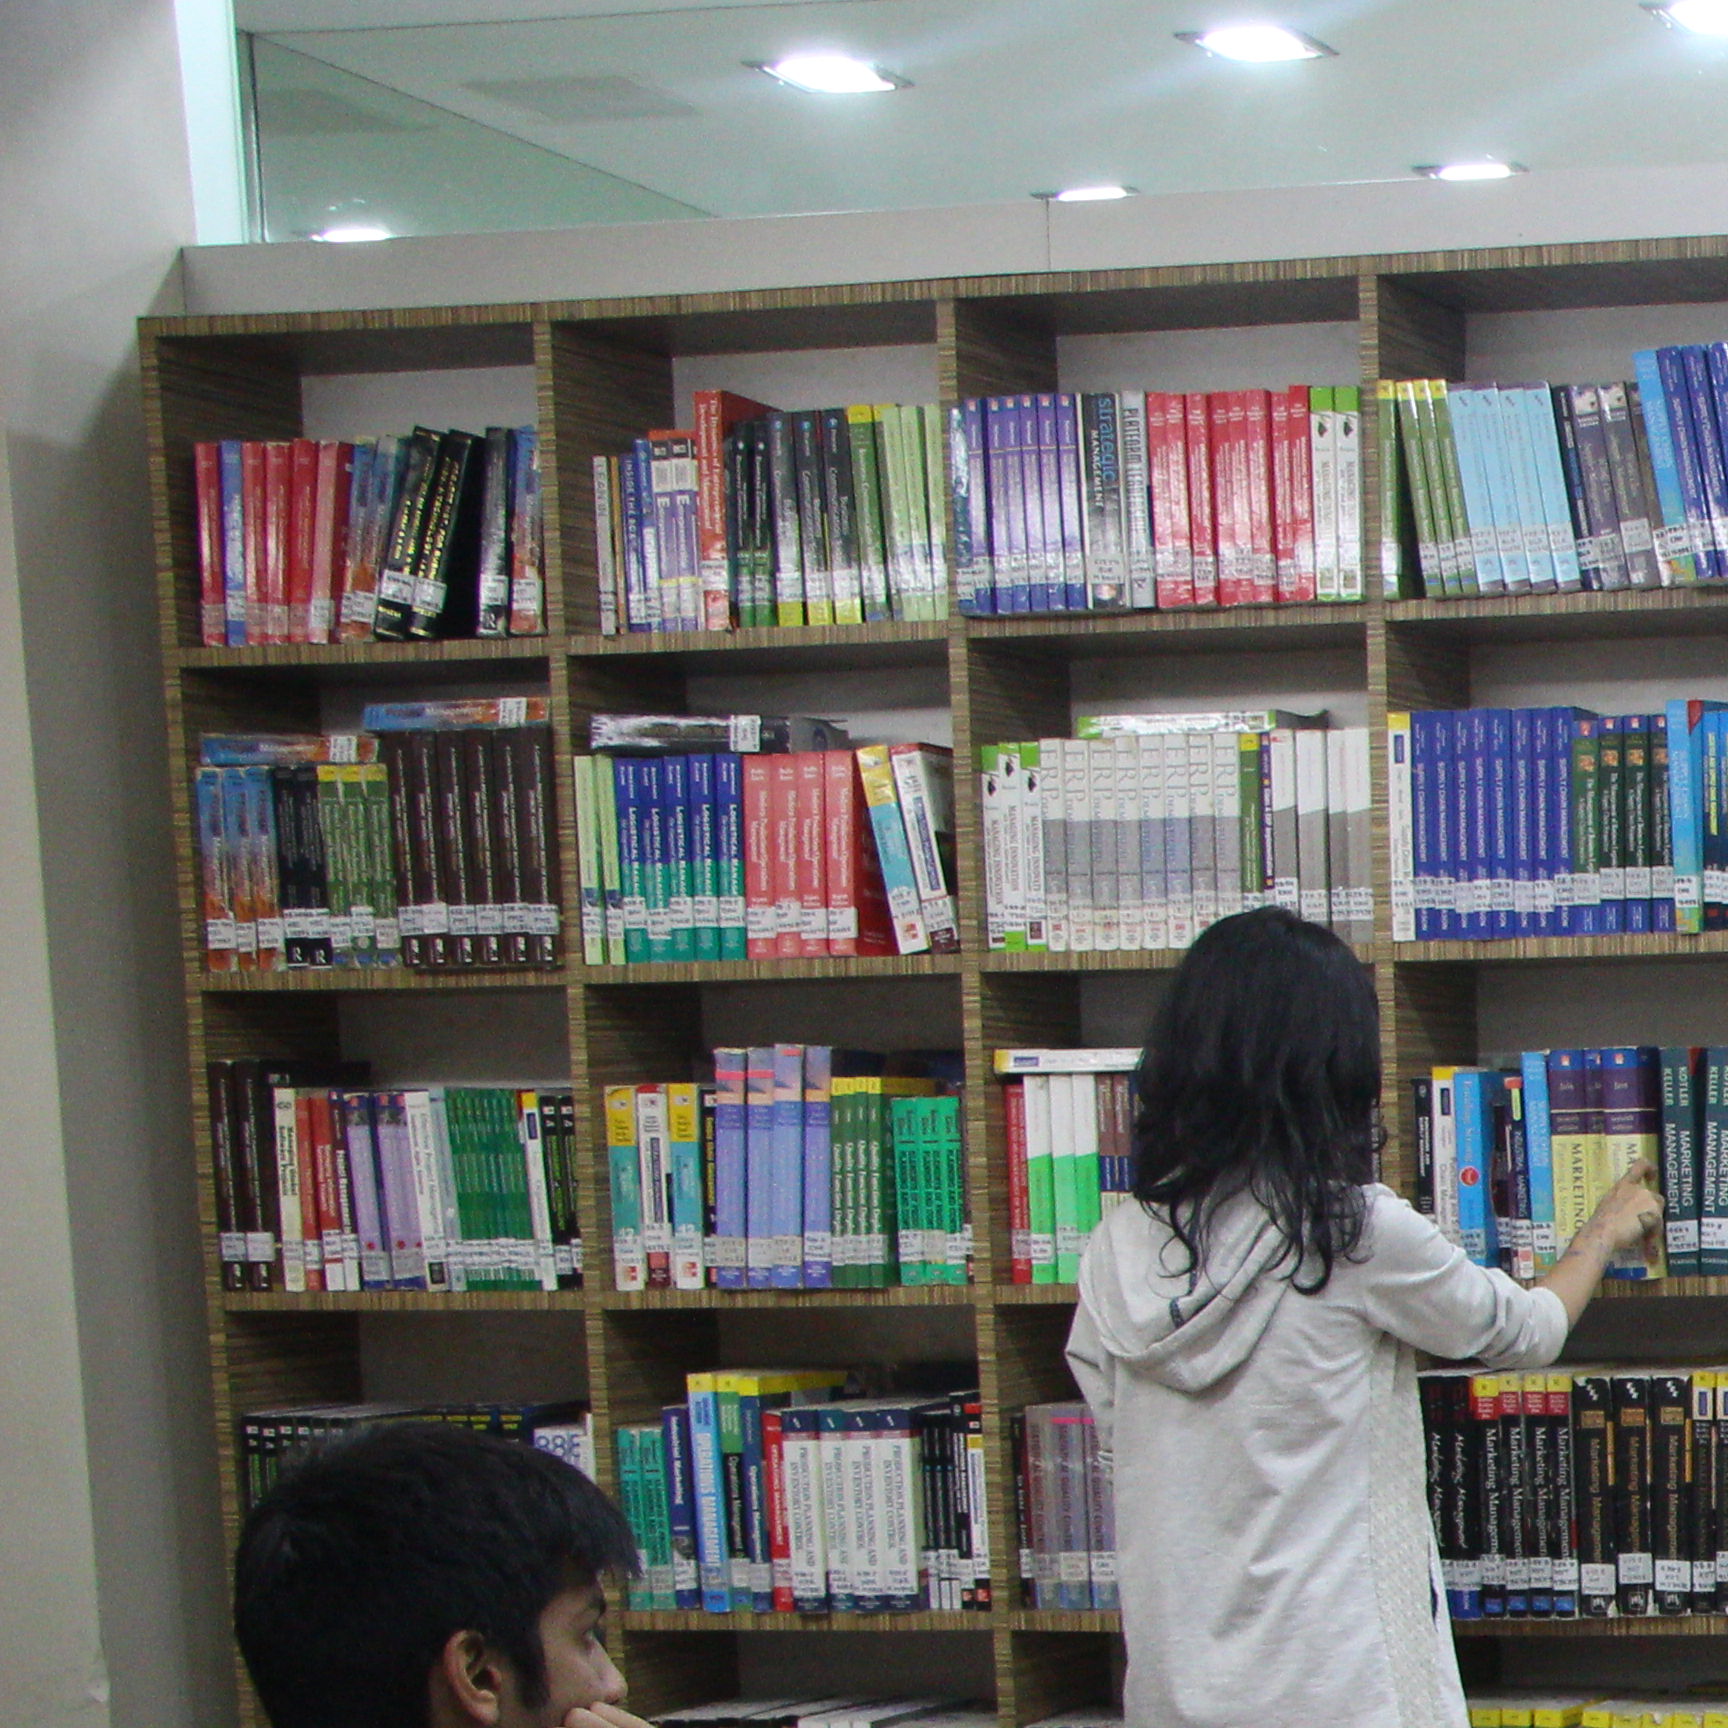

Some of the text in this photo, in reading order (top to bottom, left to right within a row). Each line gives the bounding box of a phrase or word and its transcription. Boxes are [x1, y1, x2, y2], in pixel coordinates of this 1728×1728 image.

[1099, 398, 1116, 482] strategic
[1663, 1067, 1674, 1106] KELLER
[1678, 1066, 1689, 1107] KOTLER
[1708, 1066, 1720, 1104] KELLER
[1571, 1143, 1585, 1229] MARKETING
[1665, 1123, 1682, 1215] MANAGEMENT
[1680, 1131, 1694, 1207] MARKETING
[1703, 1120, 1717, 1214] MANAGEMENT
[1509, 1427, 1522, 1486] Marketing
[1534, 1427, 1547, 1486] Marketing
[1557, 1427, 1569, 1486] Marketing
[1485, 1428, 1500, 1554] Marketing Managem
